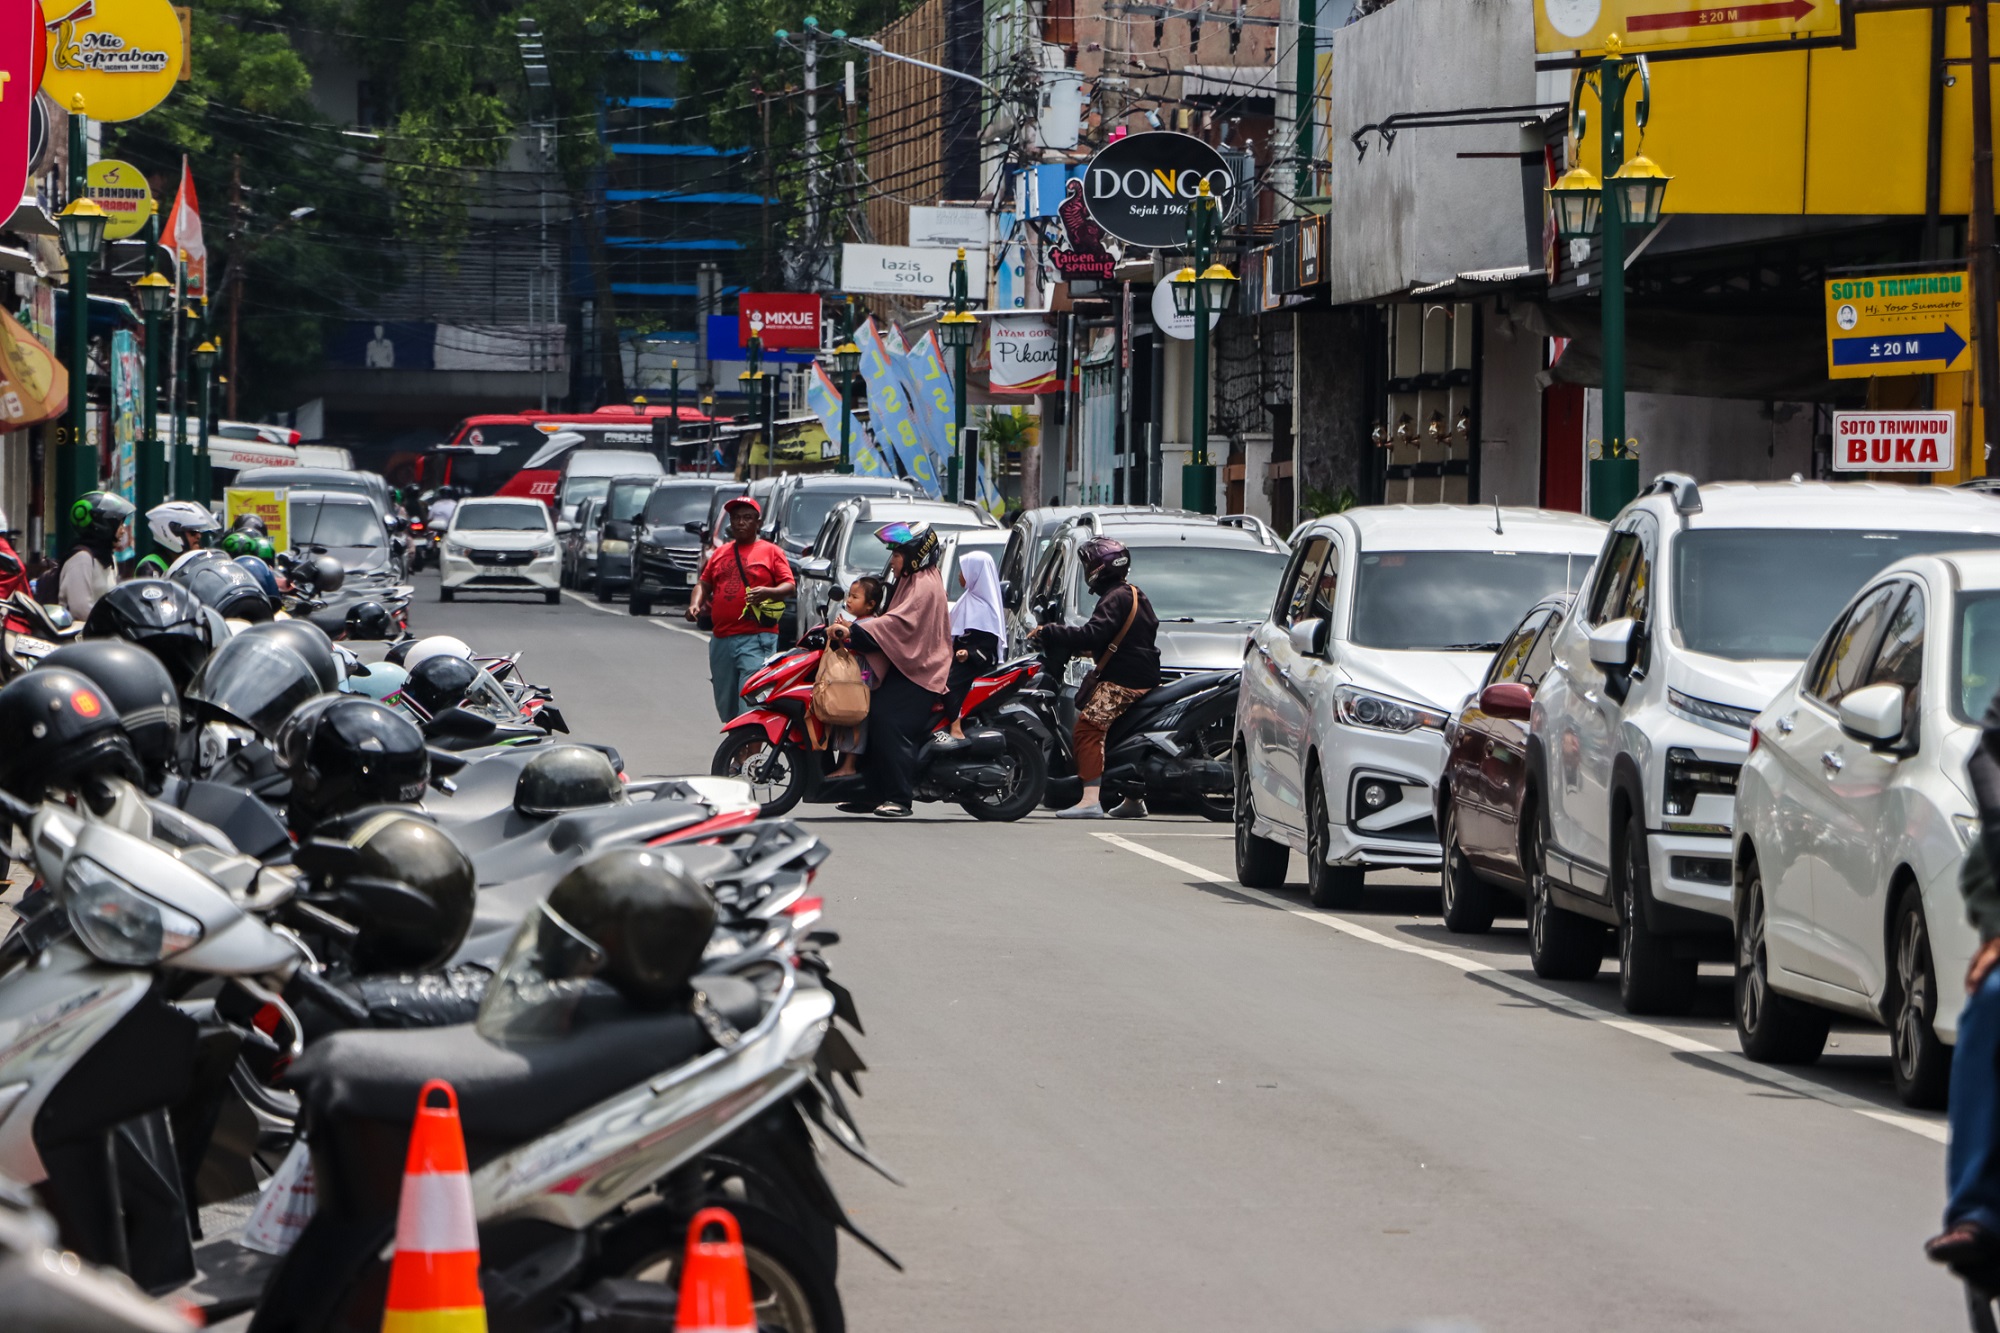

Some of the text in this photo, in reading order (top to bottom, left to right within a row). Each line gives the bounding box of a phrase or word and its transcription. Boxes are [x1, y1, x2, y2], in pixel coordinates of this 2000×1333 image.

[1710, 11, 1724, 22] 20
[1727, 10, 1738, 21] M
[83, 33, 122, 48] Mie
[1092, 169, 1232, 199] DONGO
[97, 187, 146, 199] BANDUNG
[1129, 204, 1159, 218] Sejak
[882, 258, 921, 271] lazis
[895, 272, 934, 284] solo
[1831, 276, 1963, 300] SOTO TRIWINDU
[1865, 301, 1963, 314] Hj. Yoso Sumarto
[765, 311, 814, 325] MIXUE
[996, 329, 1052, 337] AYAM GOR
[1870, 341, 1919, 357] ± 20 M
[1840, 420, 1948, 435] SOTO TRIWINDU
[1846, 438, 1939, 463] BUKA
[256, 504, 279, 514] MIE
